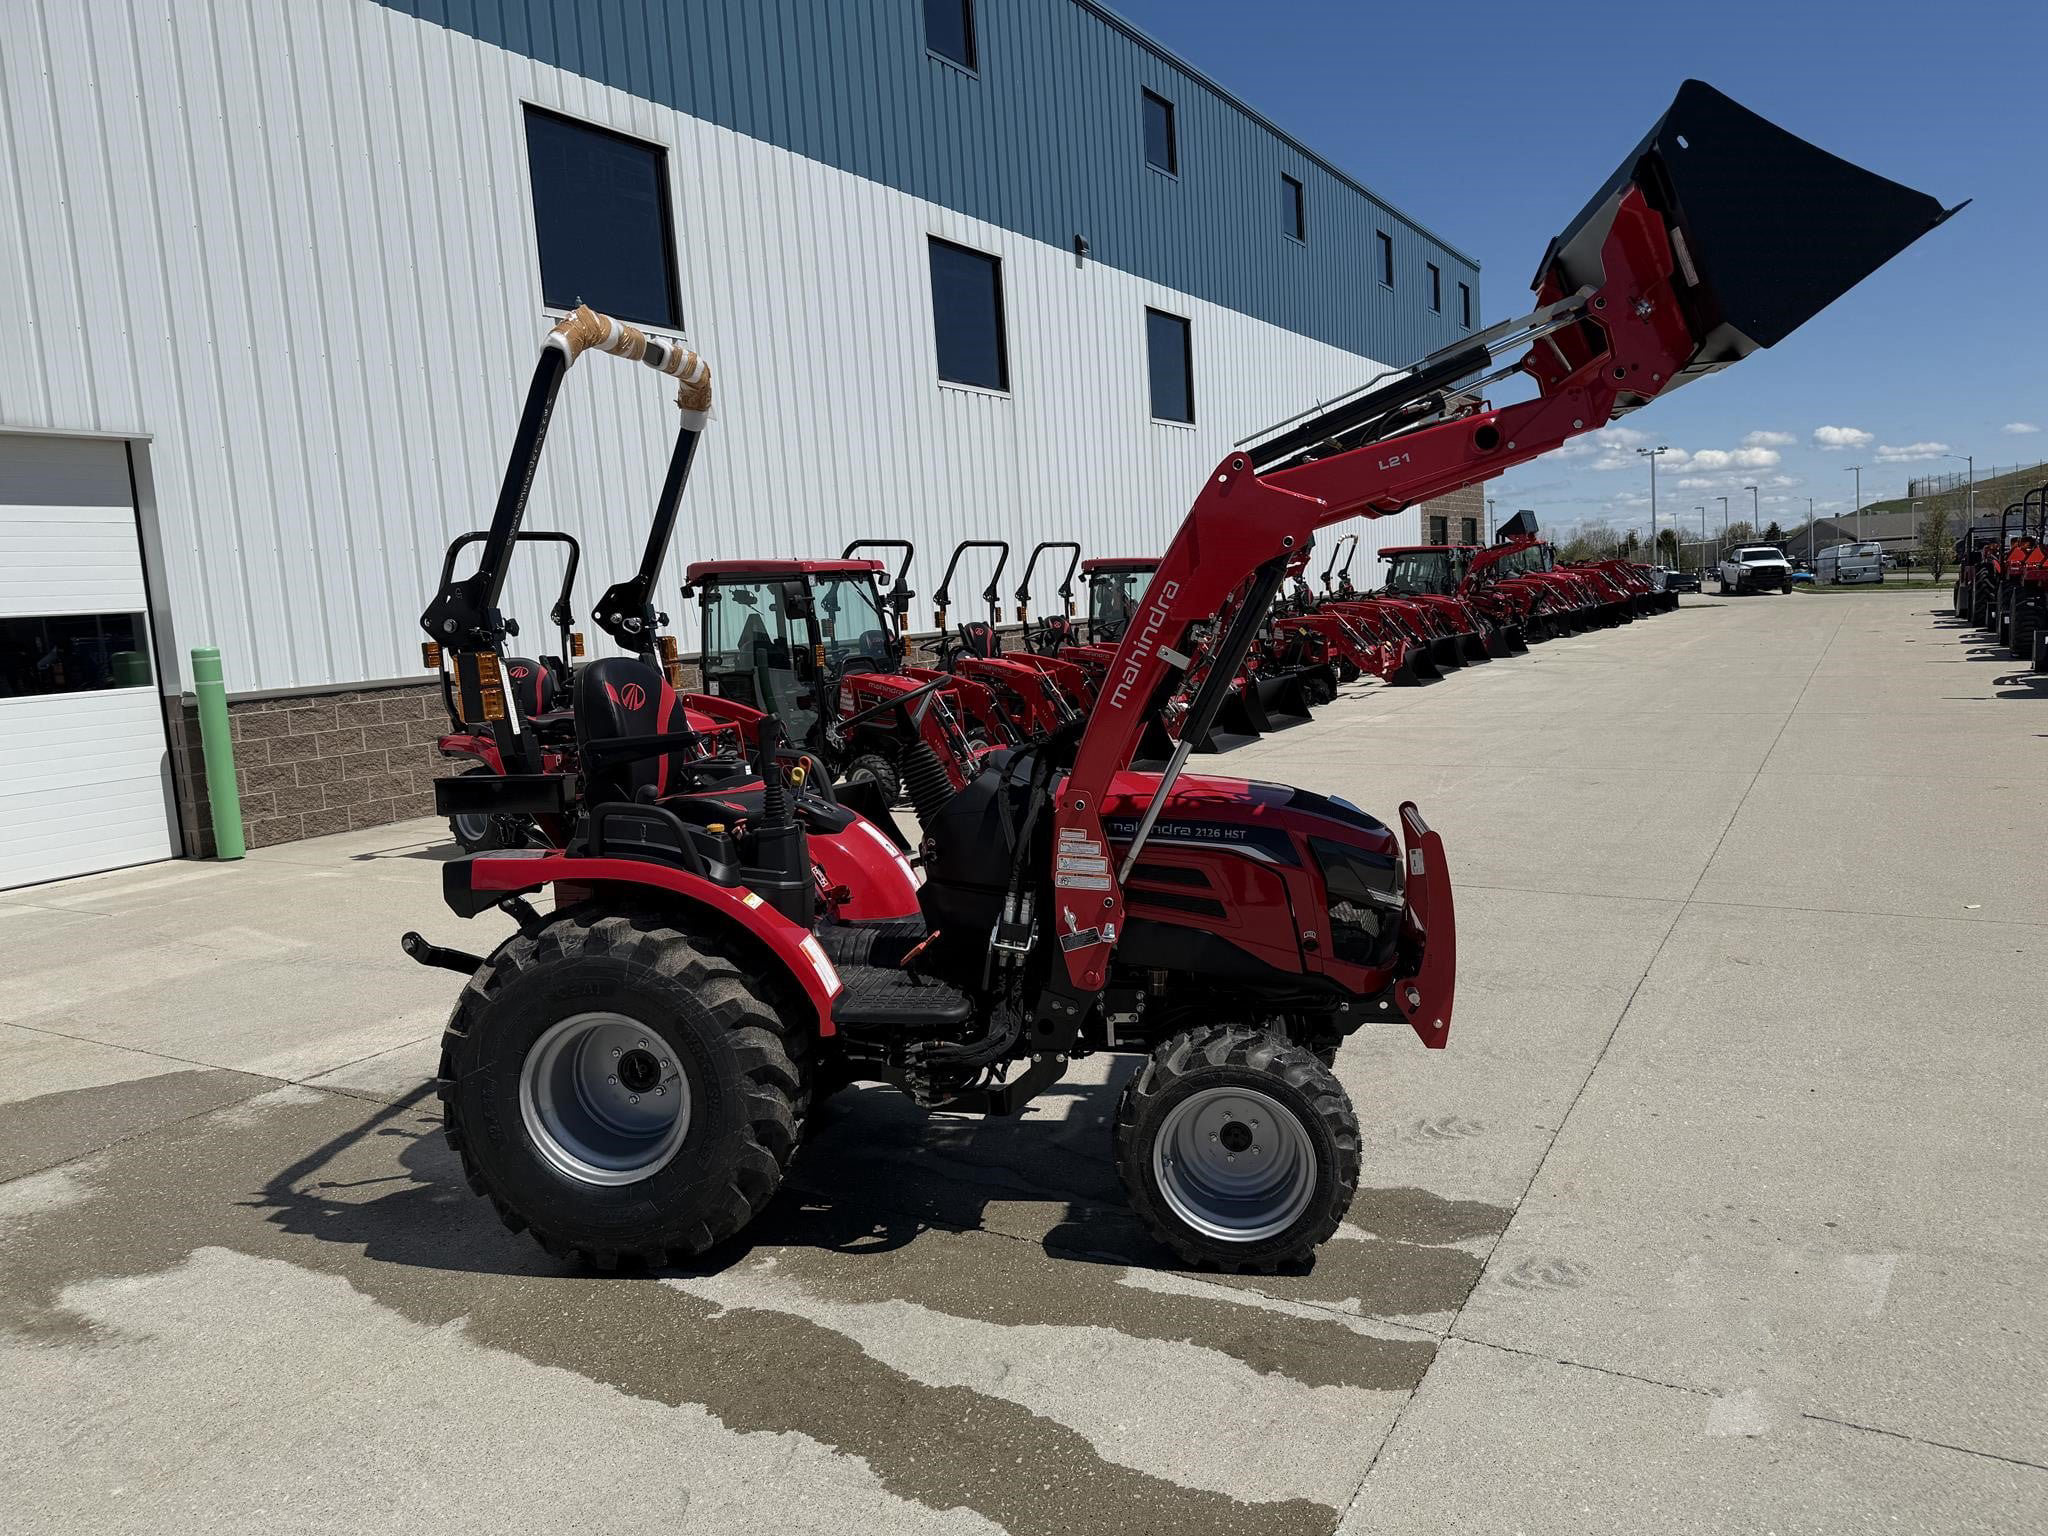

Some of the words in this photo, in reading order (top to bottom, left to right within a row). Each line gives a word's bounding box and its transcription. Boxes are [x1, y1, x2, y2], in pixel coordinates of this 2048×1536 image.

[1378, 452, 1411, 471] L21
[1110, 580, 1180, 709] mahindra
[867, 681, 904, 697] mahindra
[1108, 820, 1191, 837] mandra
[1194, 827, 1221, 838] 2126
[1224, 829, 1247, 840] HST
